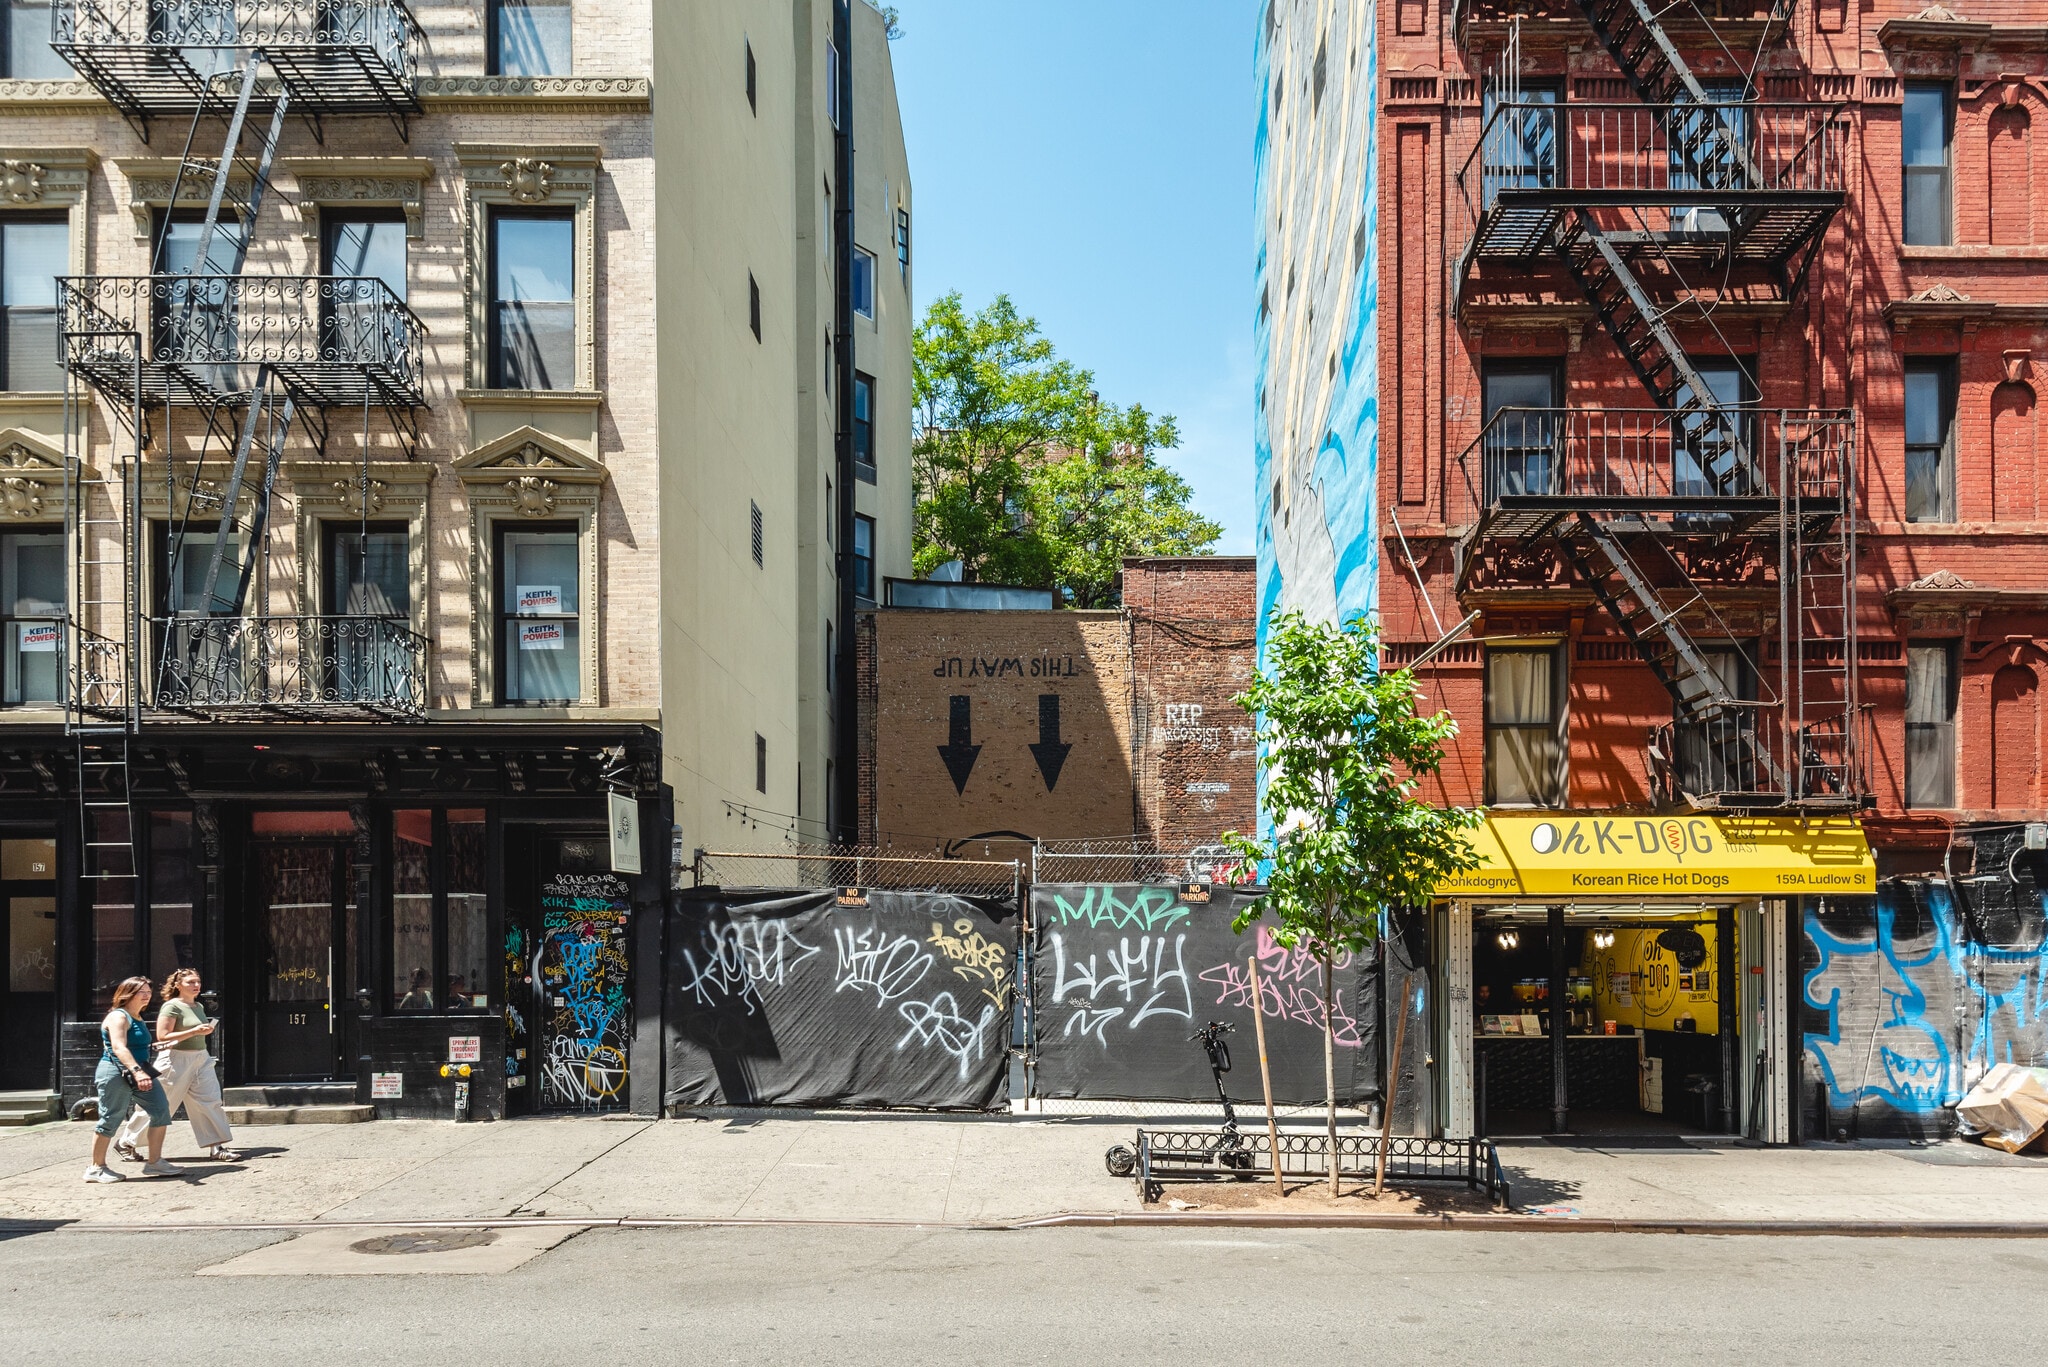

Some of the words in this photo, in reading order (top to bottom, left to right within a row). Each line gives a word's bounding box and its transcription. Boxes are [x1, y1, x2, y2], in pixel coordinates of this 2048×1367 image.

[525, 590, 552, 599] KEITH
[520, 596, 557, 607] POWERS
[29, 626, 56, 635] KEITH
[528, 624, 554, 634] KEITH
[523, 630, 559, 642] POWERS
[933, 657, 963, 678] UP
[968, 656, 1024, 678] WAY
[1030, 654, 1079, 678] THIS
[1530, 820, 1590, 854] Oh
[1722, 841, 1758, 853] TOAST
[1450, 875, 1517, 889] ohkdognyc
[1572, 873, 1624, 886] Korean
[1627, 873, 1659, 886] Rice
[1662, 873, 1688, 886] Hot
[1692, 873, 1730, 888] Dogs
[1775, 874, 1806, 885] 159A
[1808, 873, 1851, 885] Ludlow
[1853, 873, 1867, 885] St
[846, 888, 858, 897] NO
[1189, 884, 1201, 893] NO
[837, 896, 867, 905] PARKING
[1180, 892, 1209, 902] PARKING
[289, 1013, 307, 1025] 157
